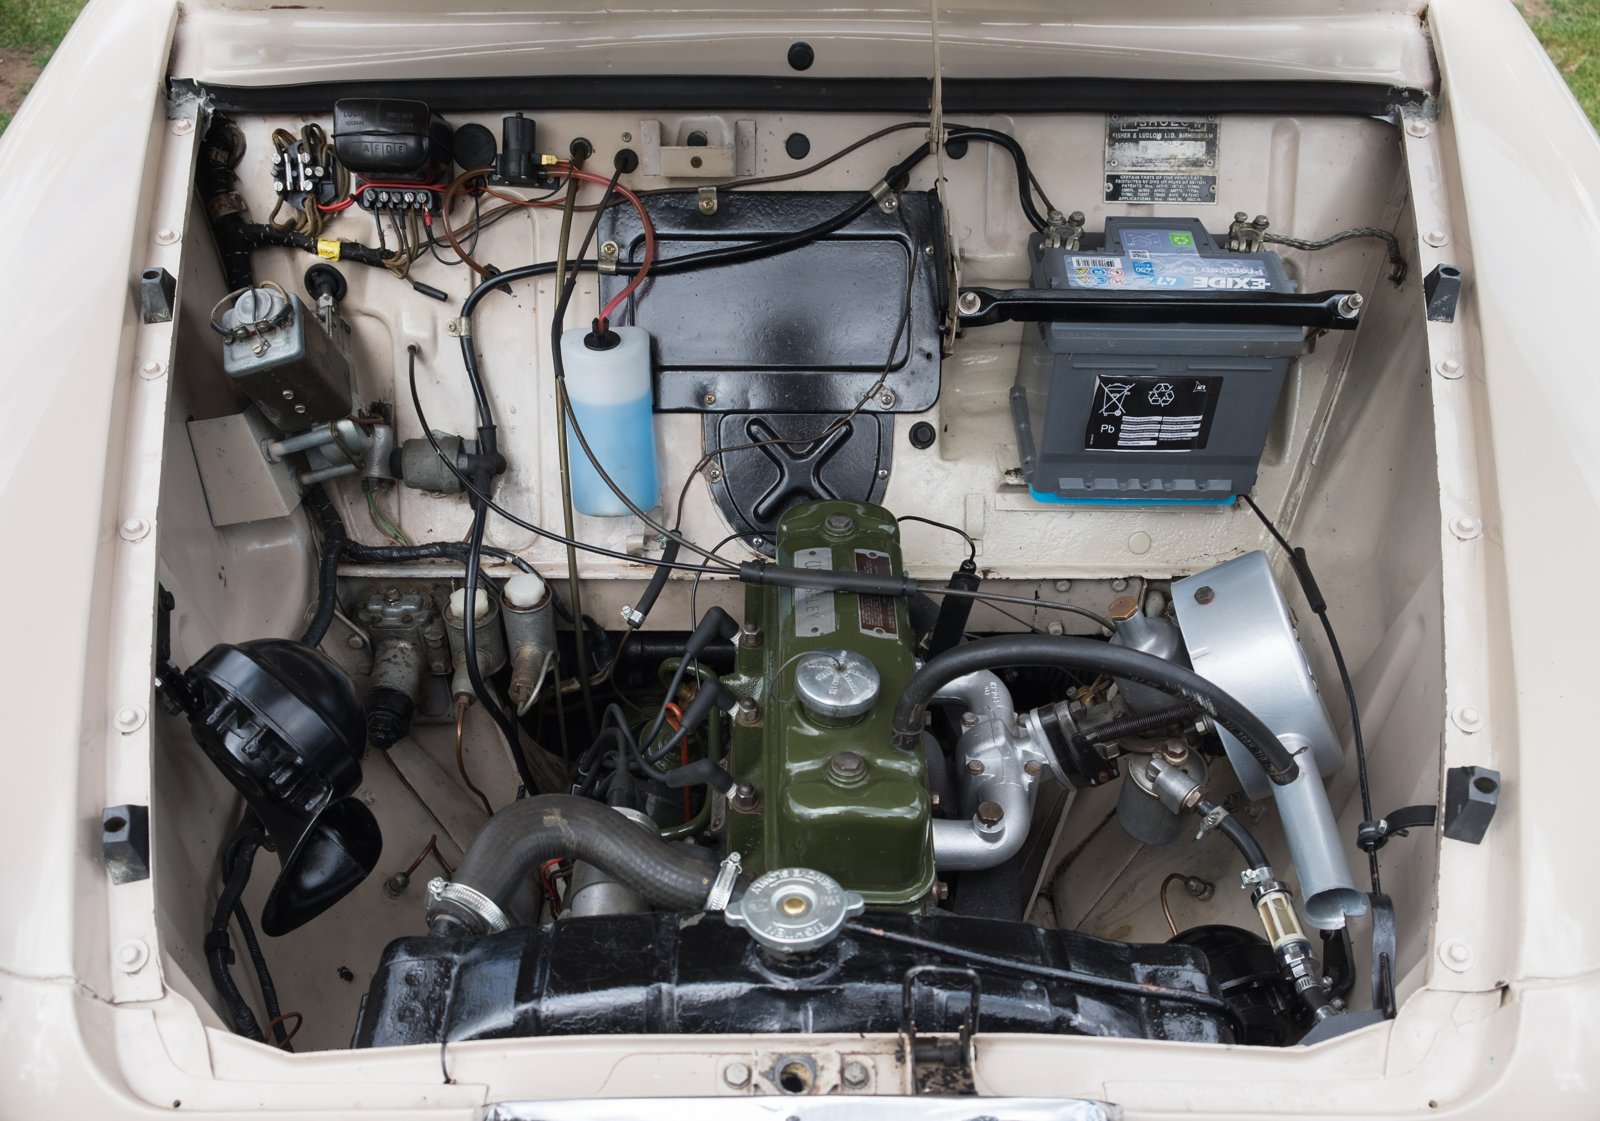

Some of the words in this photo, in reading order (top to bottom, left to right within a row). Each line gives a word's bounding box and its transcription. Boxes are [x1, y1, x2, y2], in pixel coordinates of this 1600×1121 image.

[1138, 132, 1162, 140] LUDLOW
[1193, 276, 1271, 290] EXIDE
[1100, 424, 1115, 433] Pb
